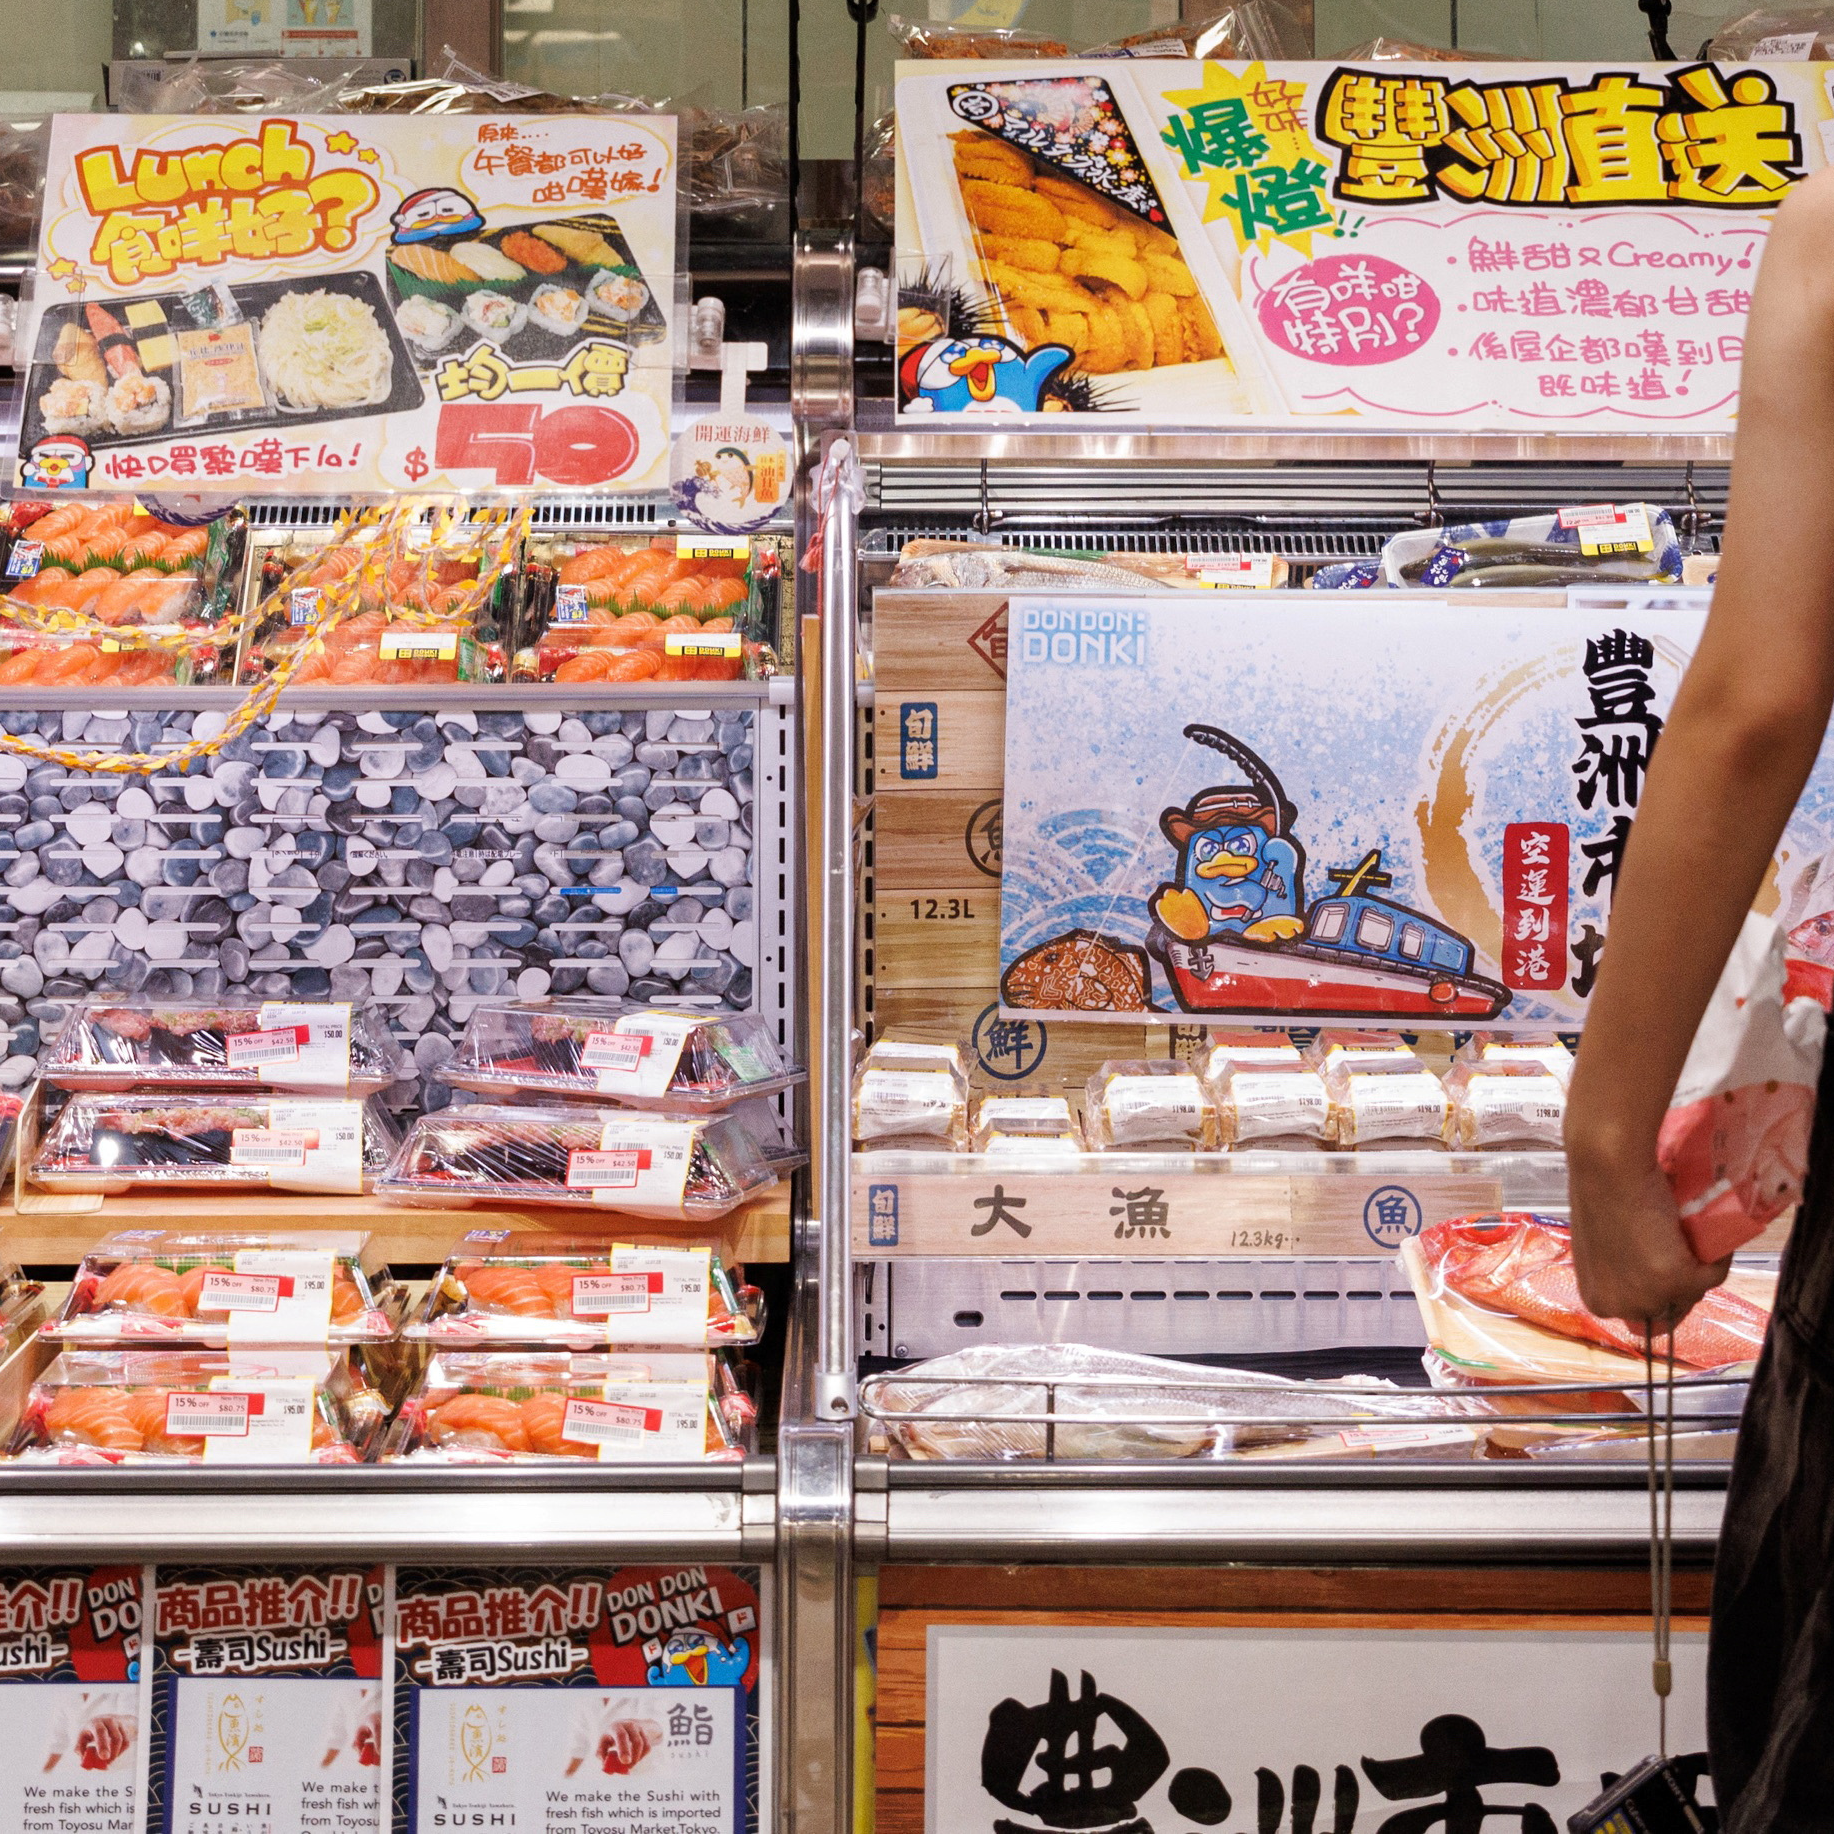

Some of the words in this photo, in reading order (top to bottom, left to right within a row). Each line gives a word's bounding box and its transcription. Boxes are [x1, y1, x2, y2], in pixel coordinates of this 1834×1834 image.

[1320, 61, 1806, 214] 豐洲直送
[75, 119, 314, 212] Lunch
[1281, 306, 1427, 354] 特別?
[439, 339, 636, 401] 均一價
[403, 449, 429, 481] $
[434, 401, 641, 486] 50
[694, 425, 771, 443] 開運海鮮
[1023, 633, 1146, 665] DONKI
[904, 707, 934, 773] 旬鮮
[909, 898, 975, 920] 12.3L
[1516, 830, 1553, 980] 空運到港
[271, 1036, 294, 1046] $42.50
[323, 1029, 343, 1039] $50.00
[1417, 1103, 1441, 1114] $198.00
[1536, 1108, 1560, 1118] $198.00
[871, 1187, 897, 1242] 旬鮮
[1375, 1193, 1414, 1234] 魚
[579, 1280, 601, 1290] 15%
[681, 1283, 701, 1293] $95.00
[397, 1584, 600, 1644] 商品推介!!
[612, 1587, 723, 1644] DONKI
[668, 1703, 714, 1747] 鮨
[434, 1813, 515, 1826] SUSHI
